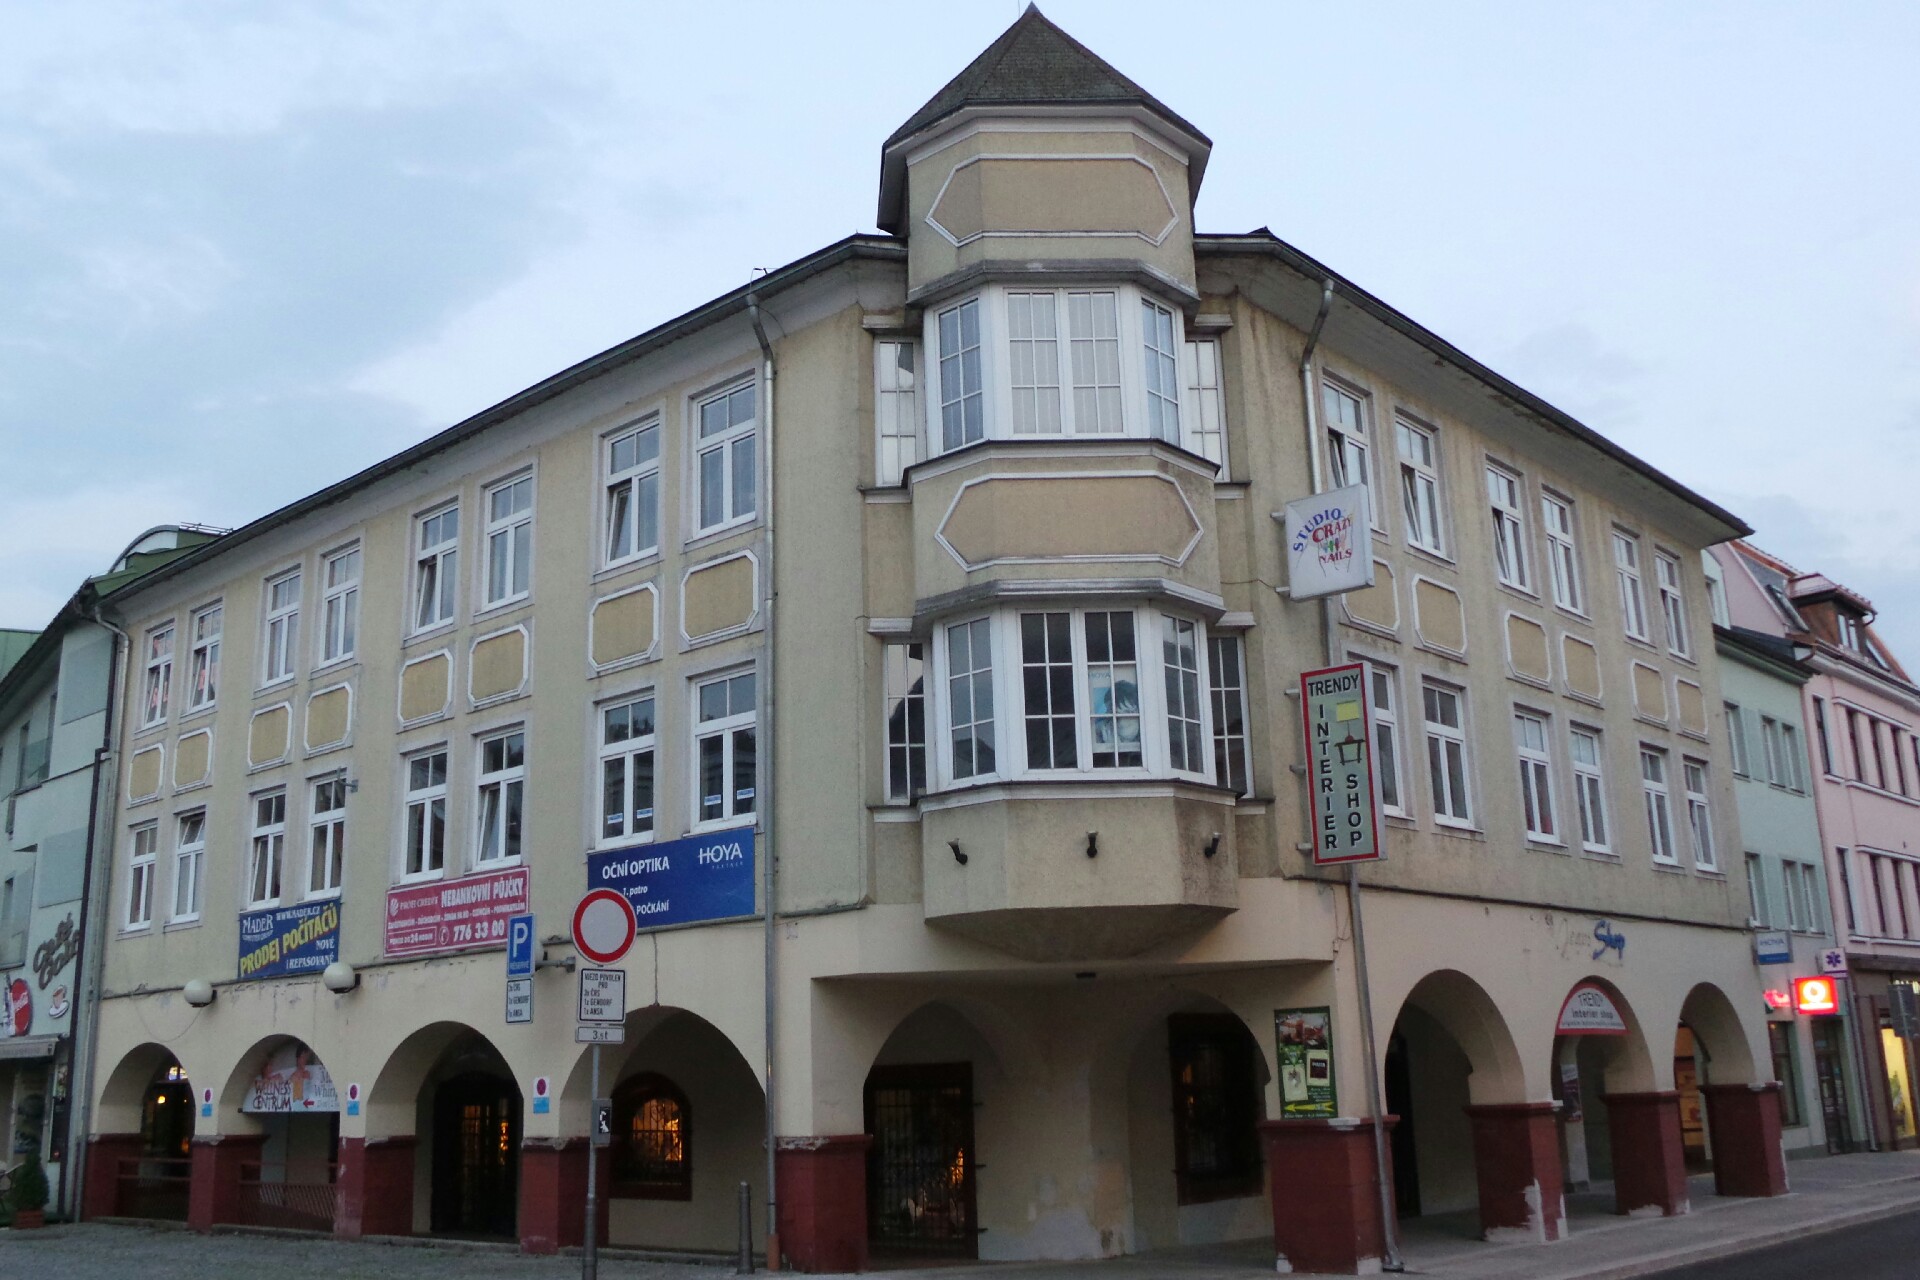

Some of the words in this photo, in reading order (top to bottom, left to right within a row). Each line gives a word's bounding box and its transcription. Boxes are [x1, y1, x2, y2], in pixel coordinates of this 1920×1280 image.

[1293, 508, 1341, 552] STUDIO
[1312, 517, 1351, 543] CRAZY
[1319, 549, 1352, 563] NAILS
[1308, 674, 1359, 697] TRENDY
[1317, 704, 1337, 850] INTERIER
[1346, 773, 1362, 847] SHOP
[698, 842, 743, 865] HOYA
[602, 859, 628, 880] OČNÍ
[629, 856, 670, 876] OPTIKA
[441, 880, 491, 908] NEBANKOVNÍ
[493, 876, 524, 899] PŮJČKY
[629, 885, 648, 898] patro
[636, 900, 670, 915] POČKÁNÍ
[242, 914, 274, 934] MADER
[453, 924, 472, 942] 776
[475, 921, 489, 939] 33
[492, 918, 505, 936] 00
[240, 938, 279, 978] PRODEJ
[282, 903, 338, 954] POČÍTAČŮ
[316, 936, 335, 950] NOVÉ
[513, 922, 528, 958] P
[253, 1095, 292, 1111] CENTRUM
